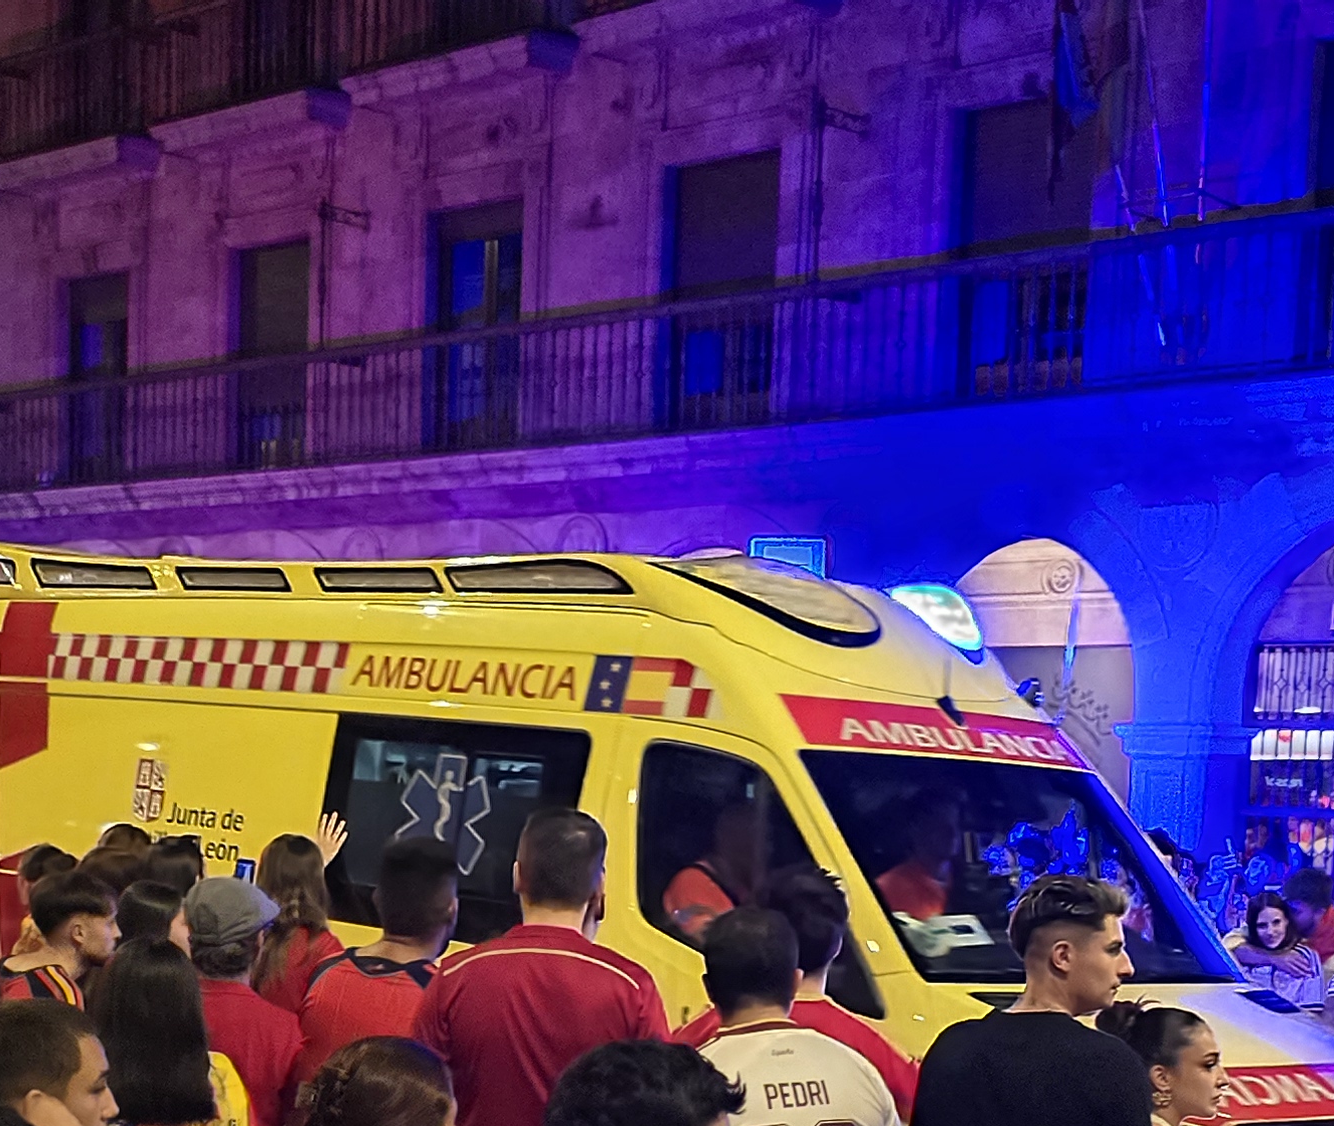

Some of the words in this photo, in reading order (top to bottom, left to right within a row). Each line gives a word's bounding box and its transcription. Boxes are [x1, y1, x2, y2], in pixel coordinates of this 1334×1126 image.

[350, 654, 577, 701] AMBULANCIA
[839, 717, 1069, 761] AMBULANCIA
[166, 802, 216, 828] Junta
[221, 809, 245, 832] de
[764, 1080, 830, 1110] PEDRI
